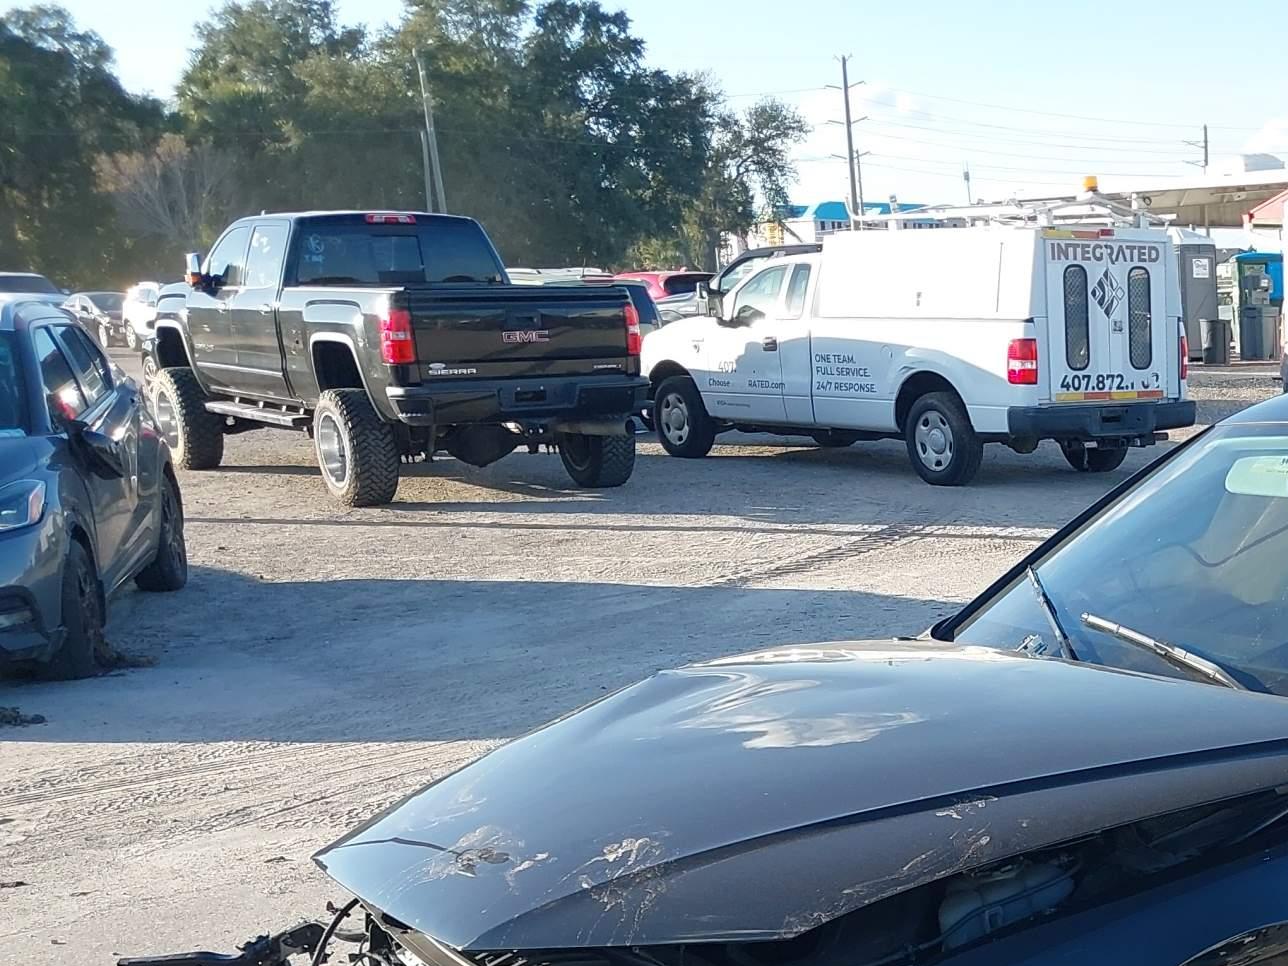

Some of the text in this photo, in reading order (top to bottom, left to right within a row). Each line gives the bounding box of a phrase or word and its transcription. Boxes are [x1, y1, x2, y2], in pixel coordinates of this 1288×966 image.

[1050, 242, 1160, 265] INTEGRATED
[502, 330, 549, 343] GMC
[814, 354, 856, 365] ONE TEAM.
[428, 367, 477, 376] SIERRA
[815, 367, 871, 378] FULL SERVICE.
[816, 381, 877, 393] 24/7 RESPONSE.
